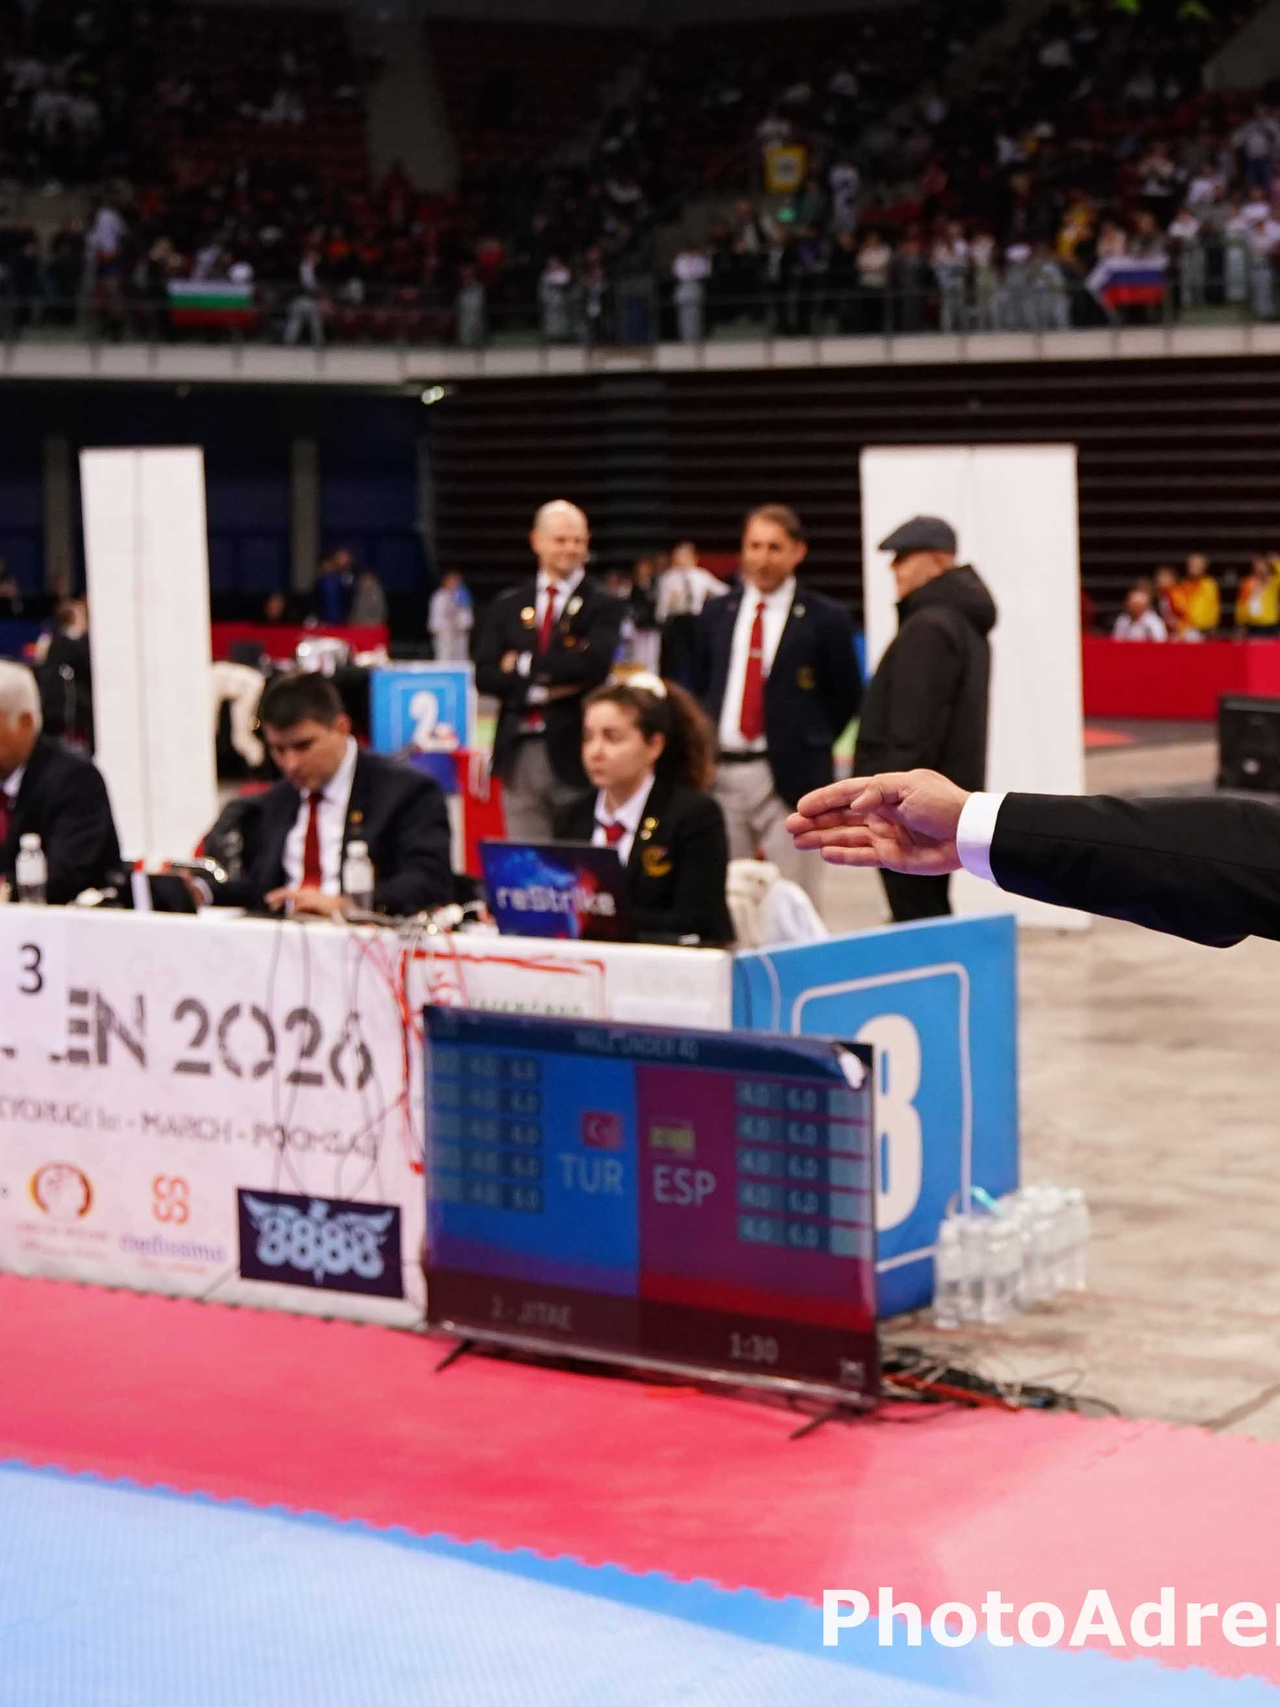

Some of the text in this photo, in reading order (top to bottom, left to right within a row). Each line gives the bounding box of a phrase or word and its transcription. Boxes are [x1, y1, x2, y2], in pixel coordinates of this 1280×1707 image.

[20, 942, 44, 995] 3
[172, 996, 375, 1091] 2026
[558, 1150, 625, 1197] TUR
[652, 1163, 717, 1208] ESP
